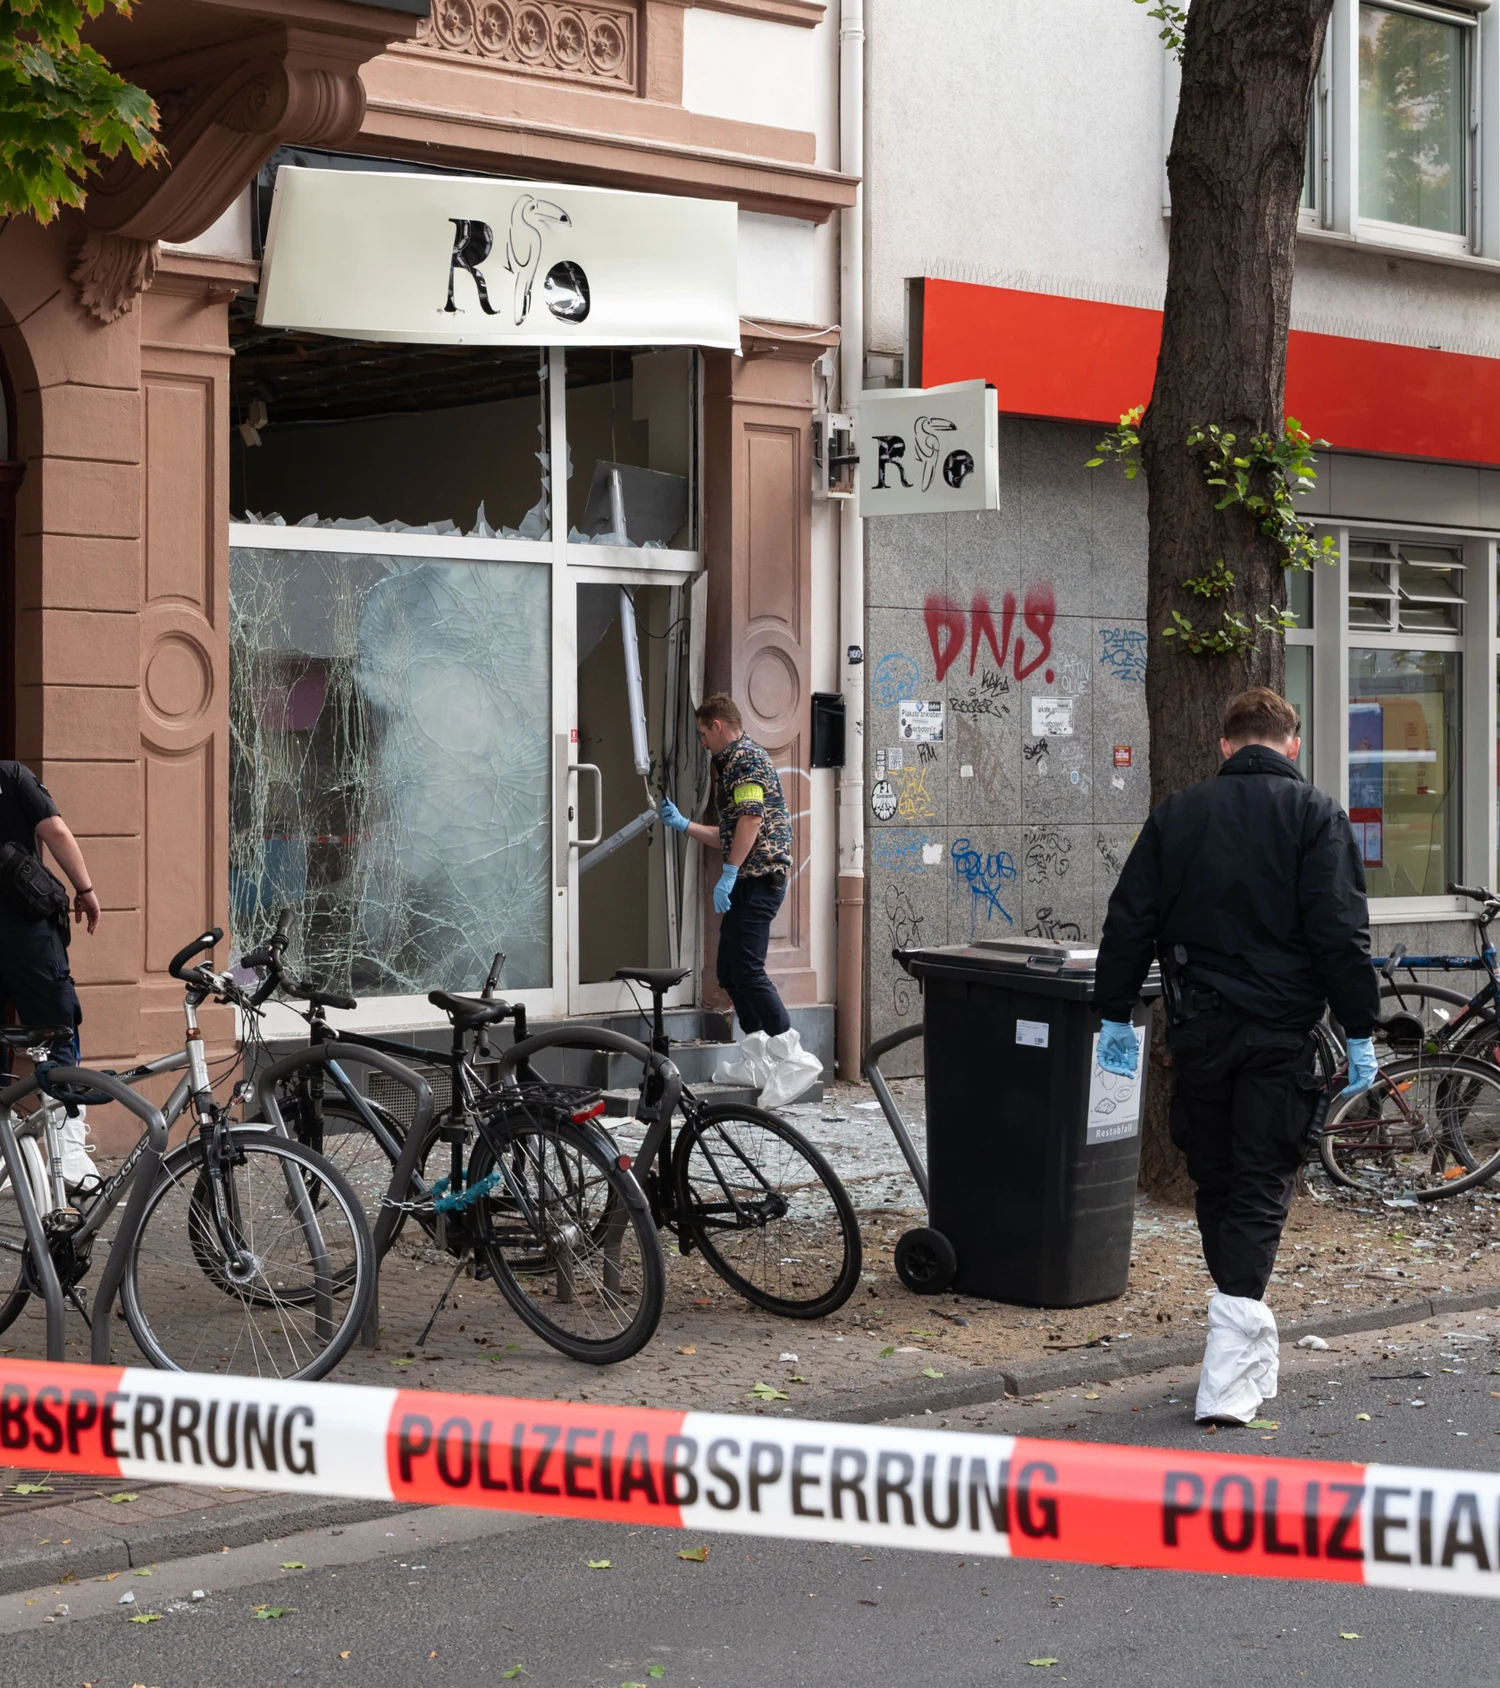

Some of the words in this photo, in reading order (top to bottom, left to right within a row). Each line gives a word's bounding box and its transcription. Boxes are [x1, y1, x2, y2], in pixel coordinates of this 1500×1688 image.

[1096, 1123, 1133, 1138] Restabfall
[398, 1413, 1059, 1541] POLIZEIABSPERRUNG
[1161, 1470, 1500, 1574] POLIZEIA
